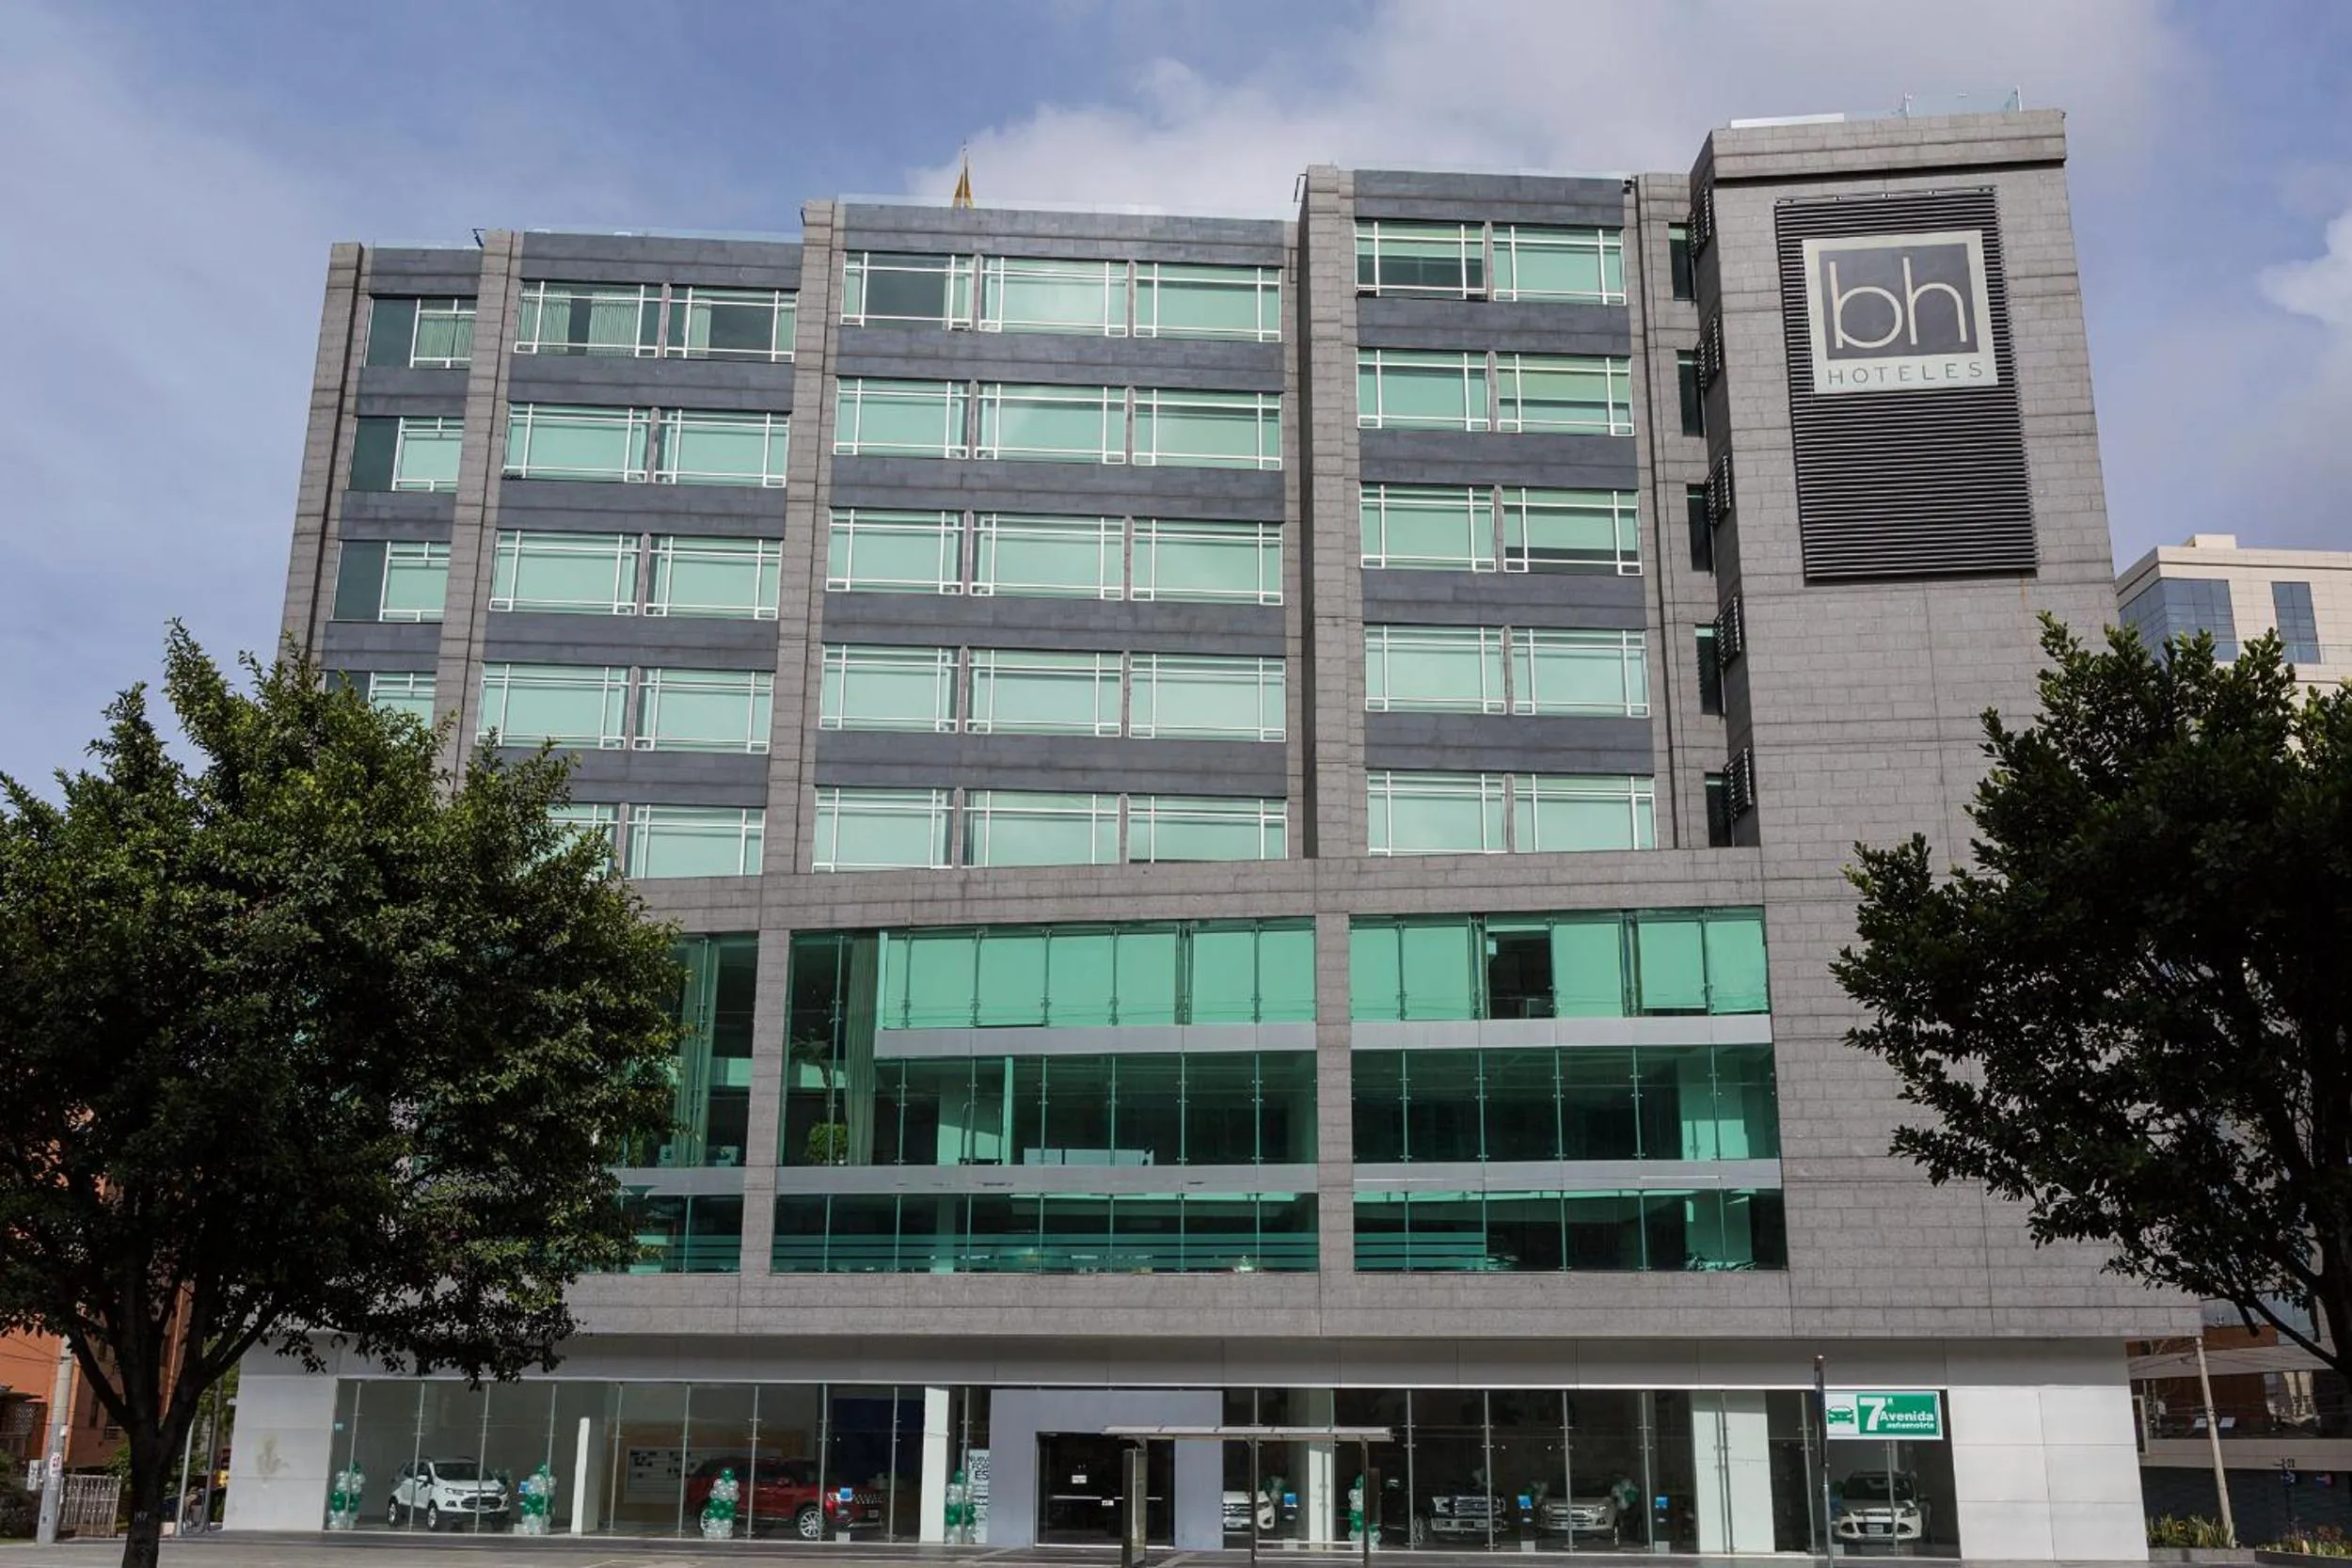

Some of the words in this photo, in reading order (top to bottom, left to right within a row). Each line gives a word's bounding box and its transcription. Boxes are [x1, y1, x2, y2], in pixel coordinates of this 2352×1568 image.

[1829, 257, 1967, 349] bh
[1827, 361, 1983, 386] HOTELES
[1880, 1410, 1934, 1421] Avenida
